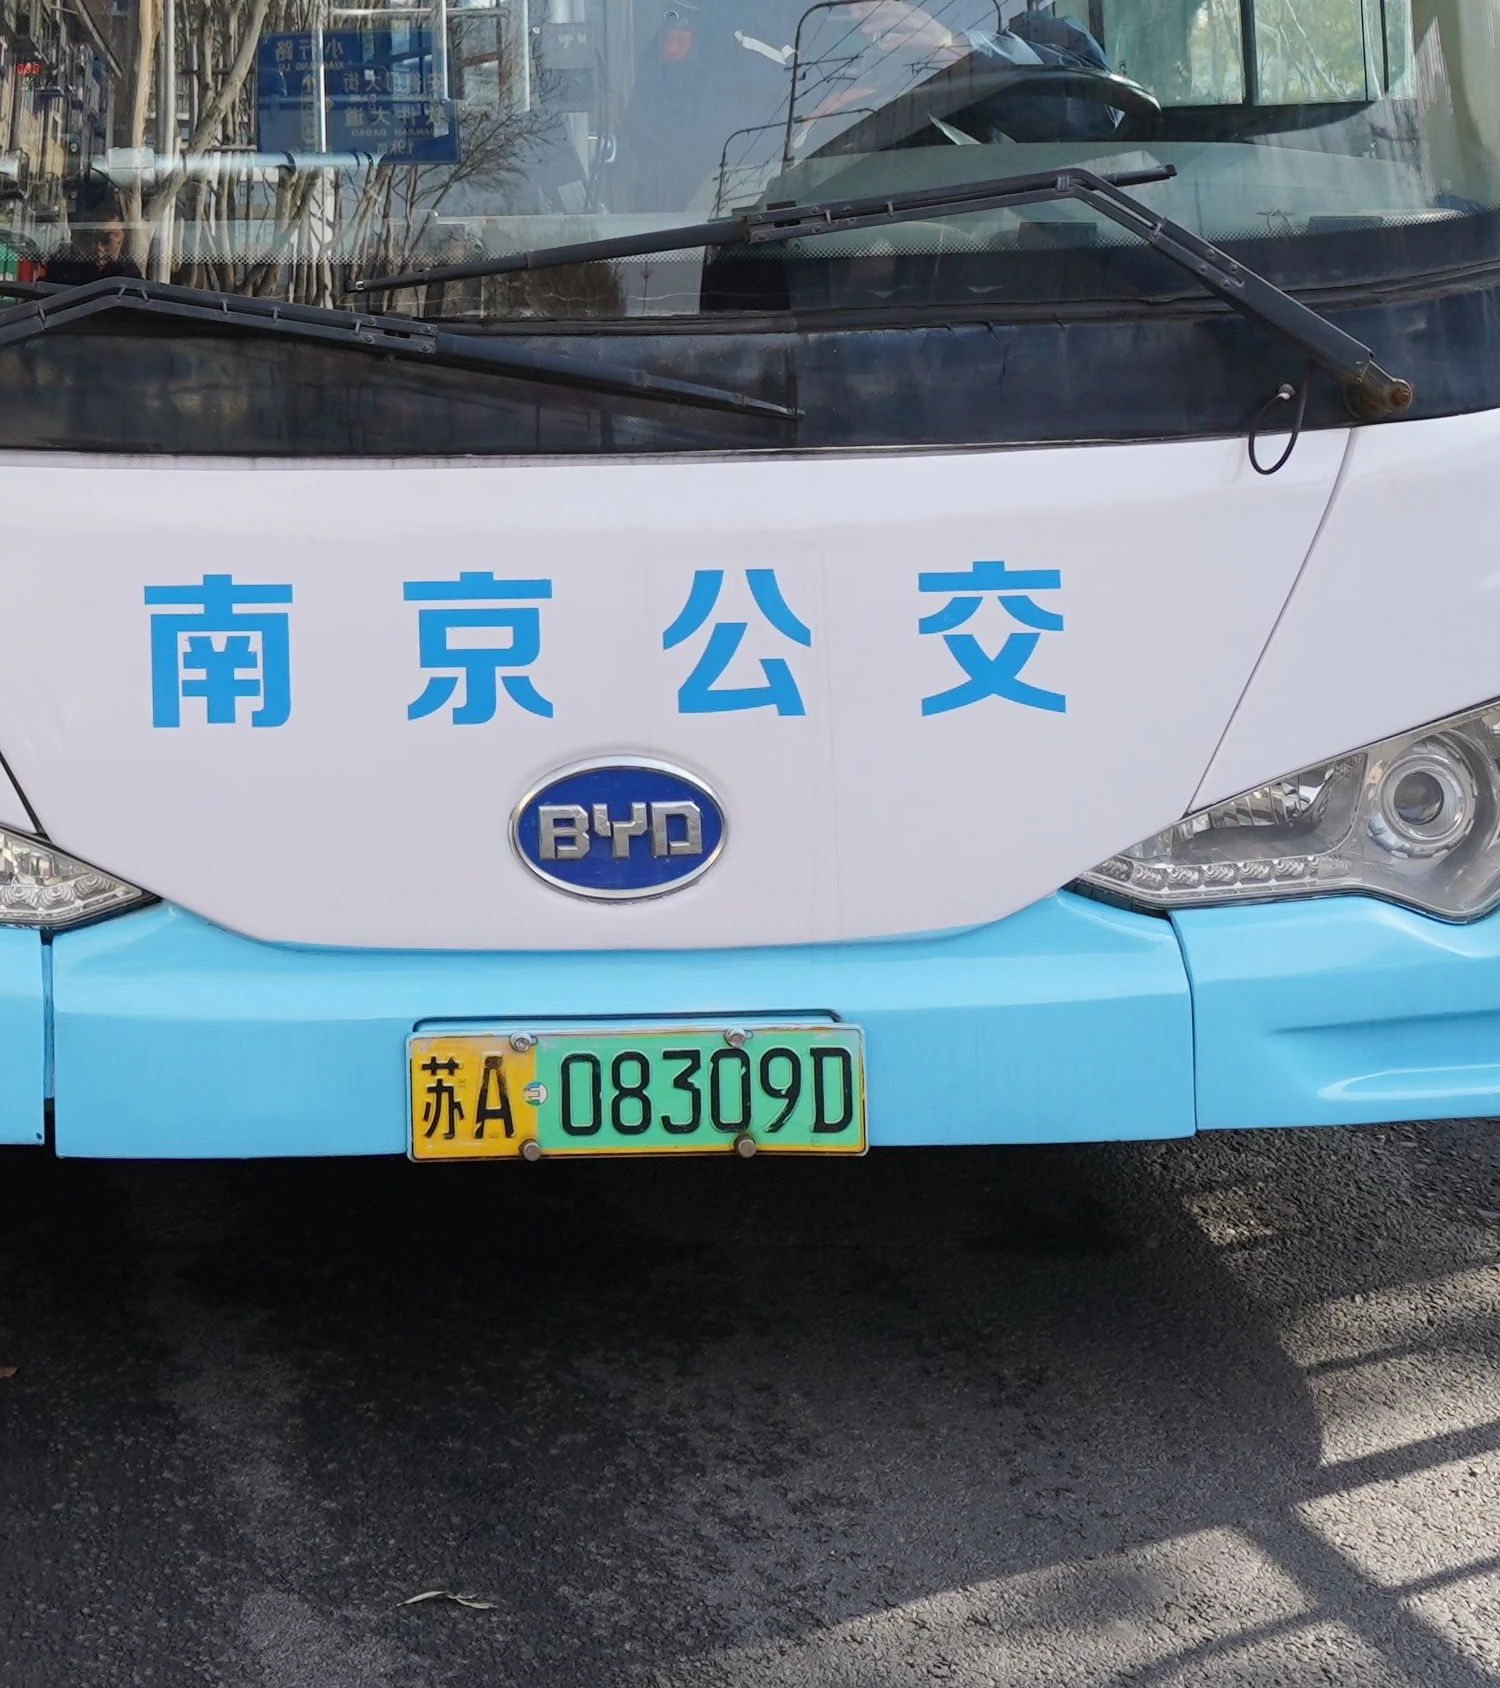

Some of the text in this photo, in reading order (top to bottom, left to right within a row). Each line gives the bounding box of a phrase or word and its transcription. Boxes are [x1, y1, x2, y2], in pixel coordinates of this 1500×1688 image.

[143, 560, 1068, 730] 南京公交
[537, 800, 704, 862] BYD
